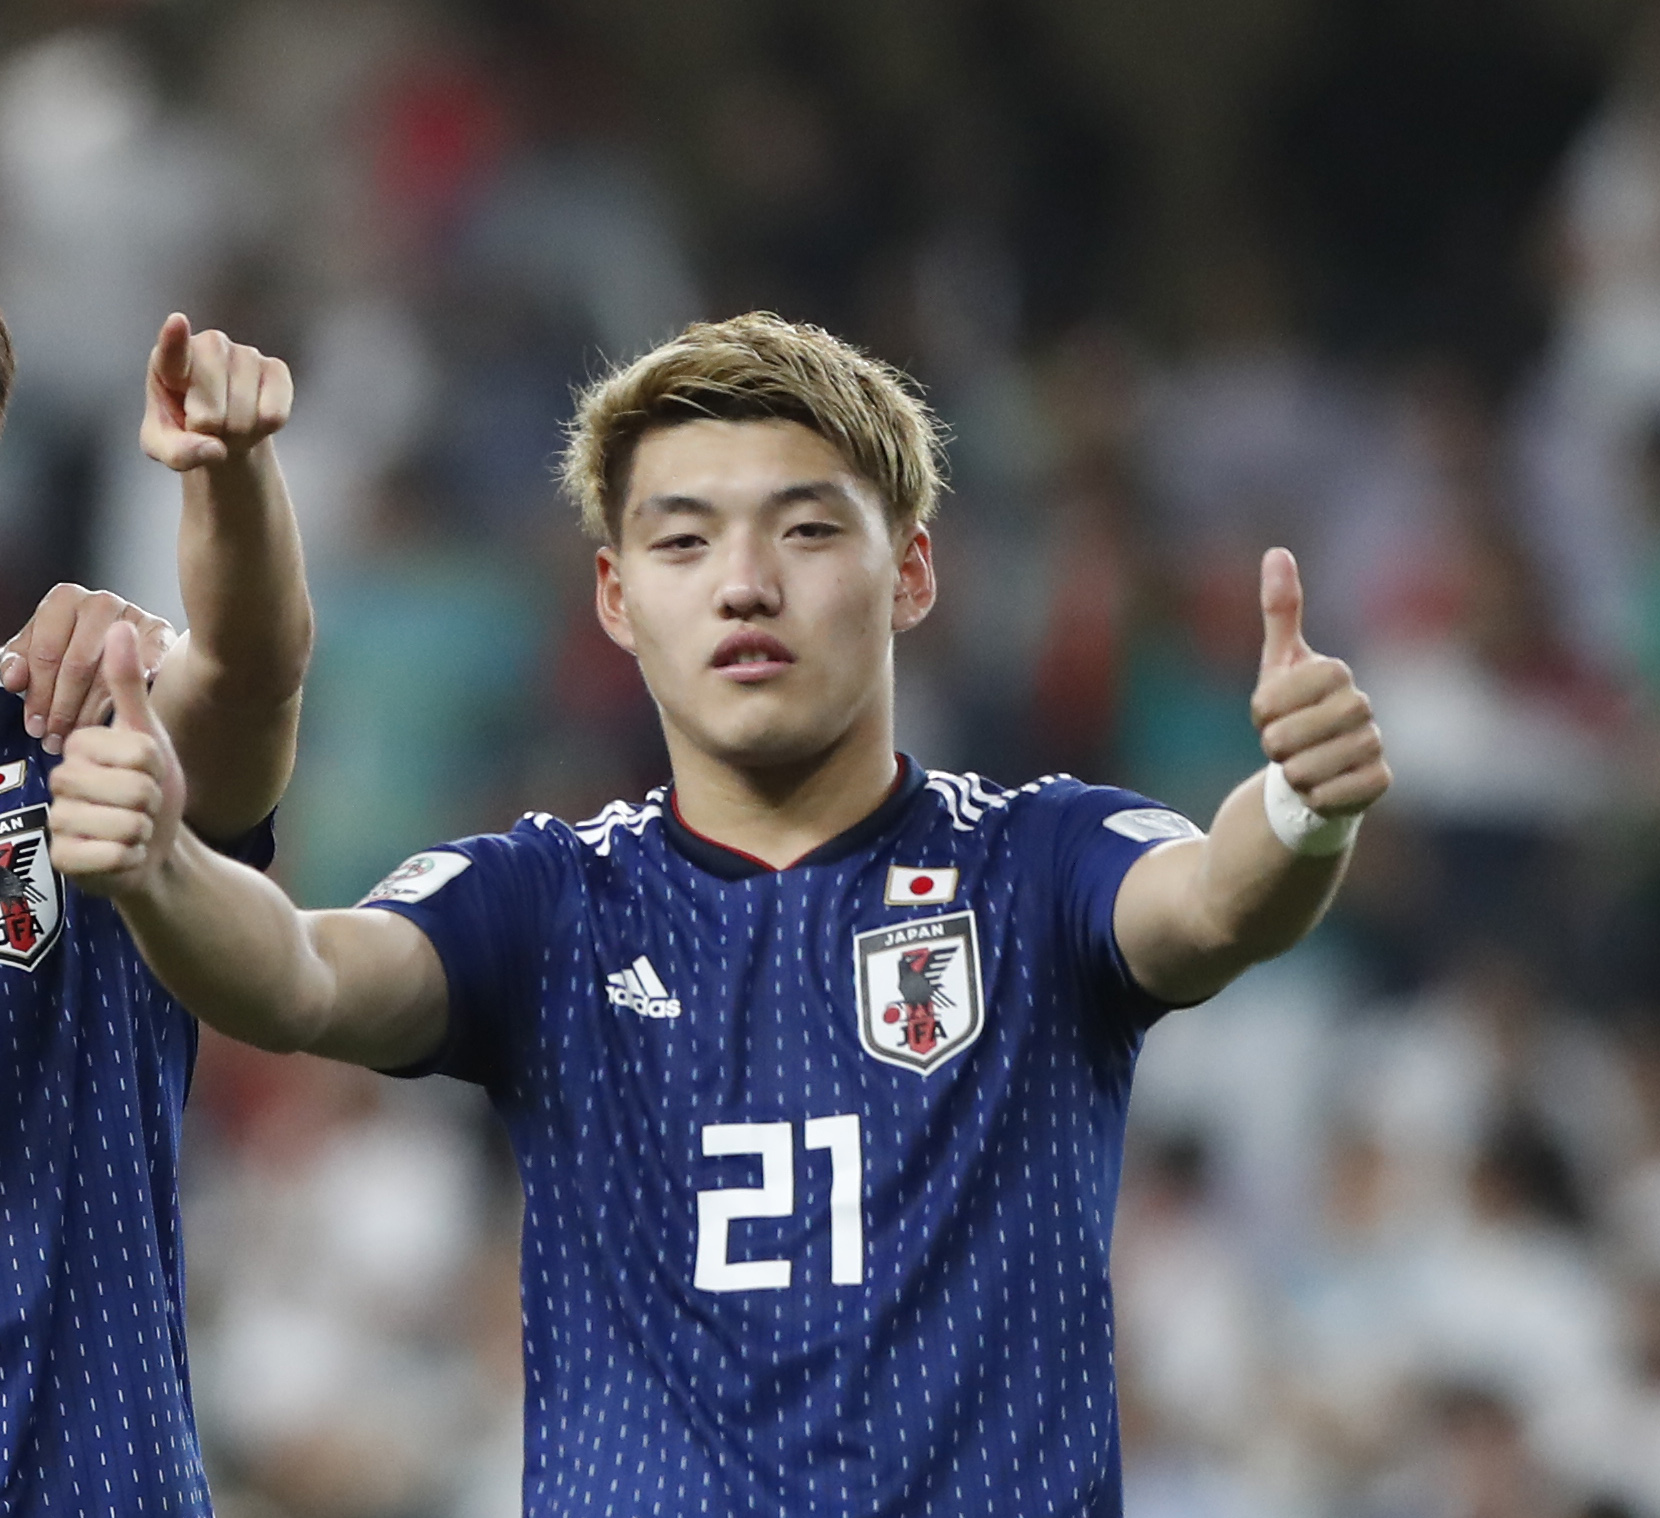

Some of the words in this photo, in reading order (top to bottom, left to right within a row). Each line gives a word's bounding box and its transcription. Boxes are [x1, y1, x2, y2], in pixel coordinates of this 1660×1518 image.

[884, 923, 945, 947] JAPAN
[896, 1021, 948, 1046] JFA
[694, 1114, 864, 1292] 21
